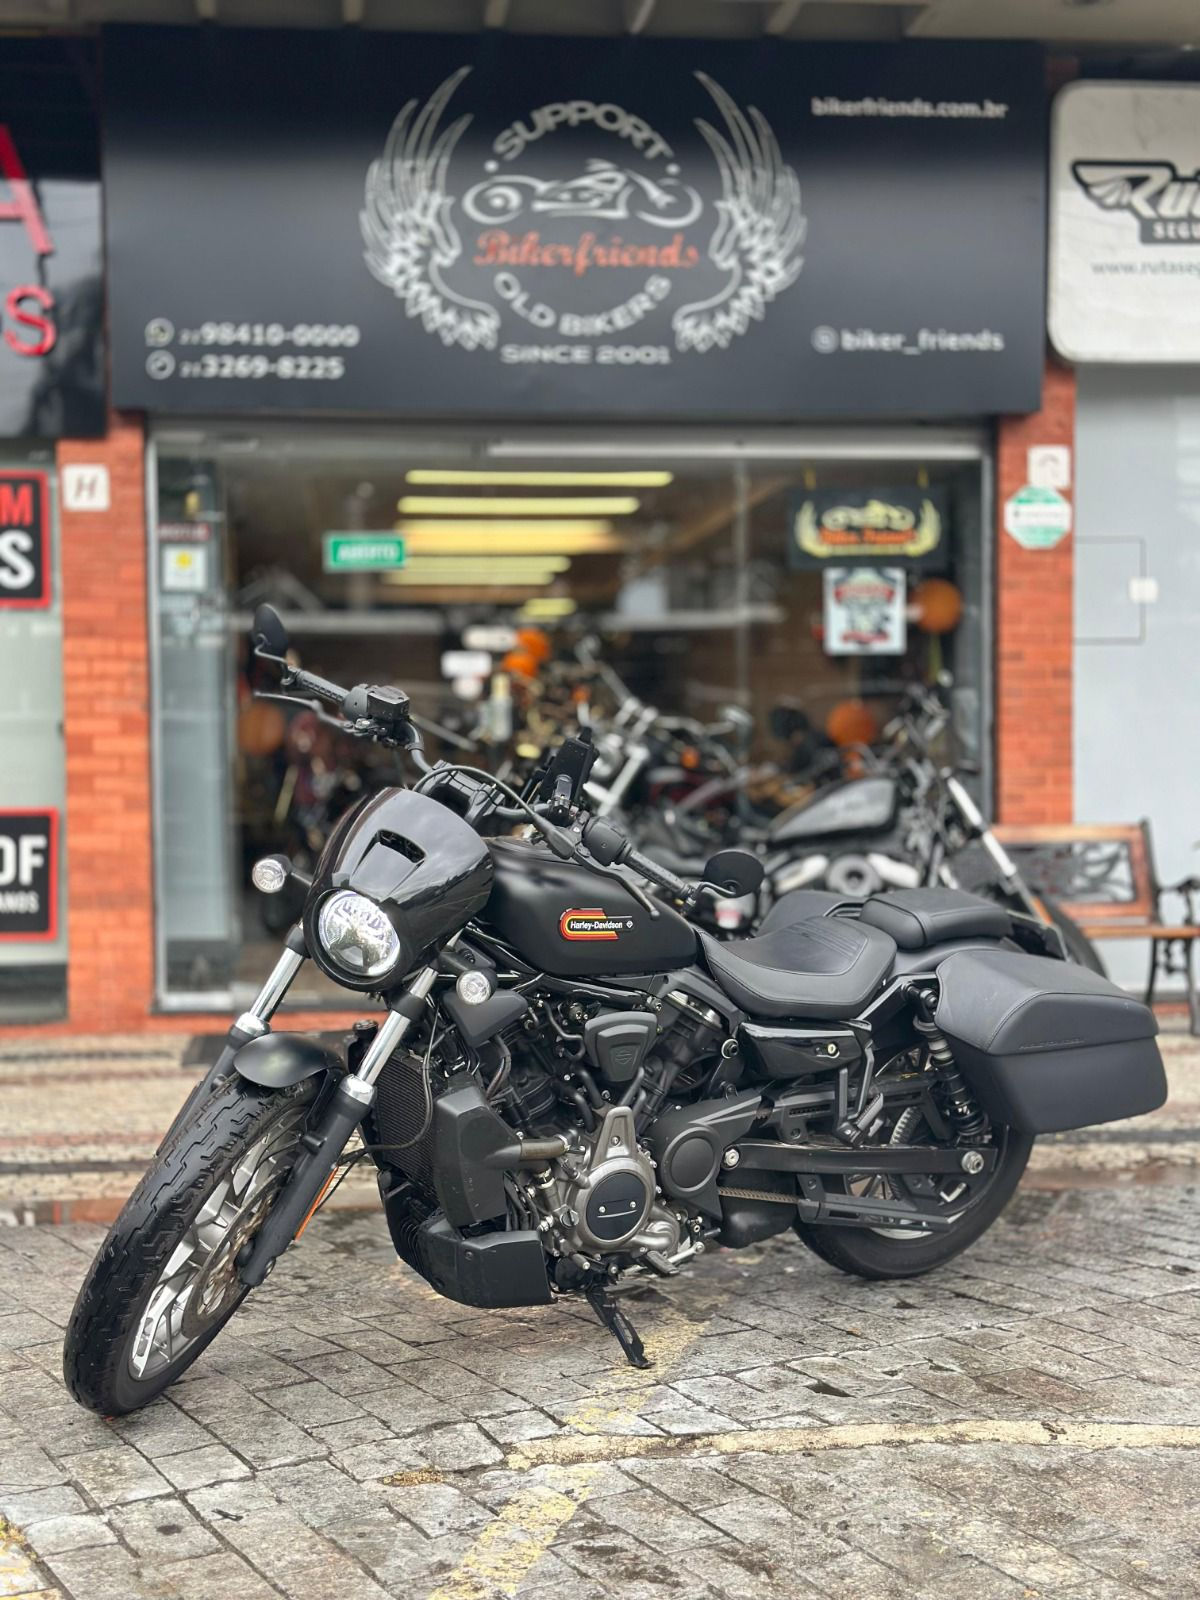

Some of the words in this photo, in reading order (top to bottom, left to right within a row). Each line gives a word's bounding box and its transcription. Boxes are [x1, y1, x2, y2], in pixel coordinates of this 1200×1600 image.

[811, 97, 1009, 119] bikerfriends.com.br
[493, 101, 674, 161] SUPPORT
[472, 229, 699, 277] Bikerfriends
[5, 285, 56, 356] S
[493, 272, 557, 328] OLD
[558, 274, 672, 337] BIKERS
[500, 344, 593, 364] SINCE
[595, 345, 672, 365] 2001
[840, 328, 1005, 355] biker_friends
[570, 920, 623, 931] Harley-Davidson
